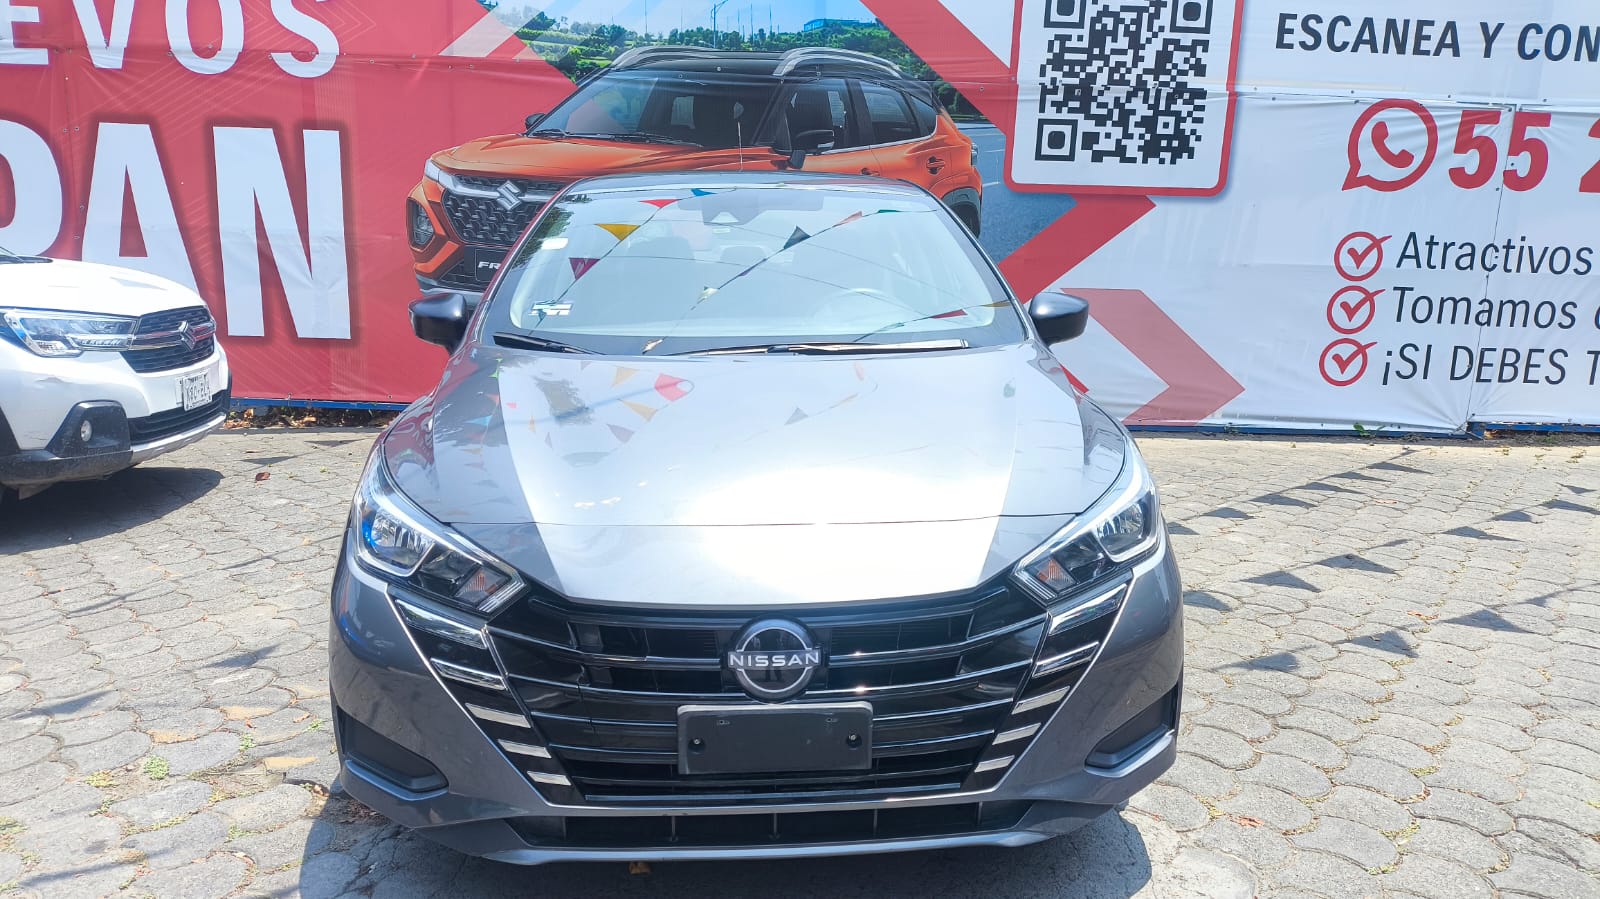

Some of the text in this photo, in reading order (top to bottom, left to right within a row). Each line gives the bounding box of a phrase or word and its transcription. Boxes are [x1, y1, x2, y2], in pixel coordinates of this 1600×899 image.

[1276, 13, 1460, 57] ESCANEA
[1479, 22, 1504, 58] Y
[1449, 110, 1551, 191] 55
[1396, 232, 1594, 275] Atractivos
[1393, 286, 1577, 329] Tomamos
[1382, 343, 1432, 385] ¡SI
[1450, 345, 1568, 385] DEBES
[730, 653, 819, 667] NISSAN
